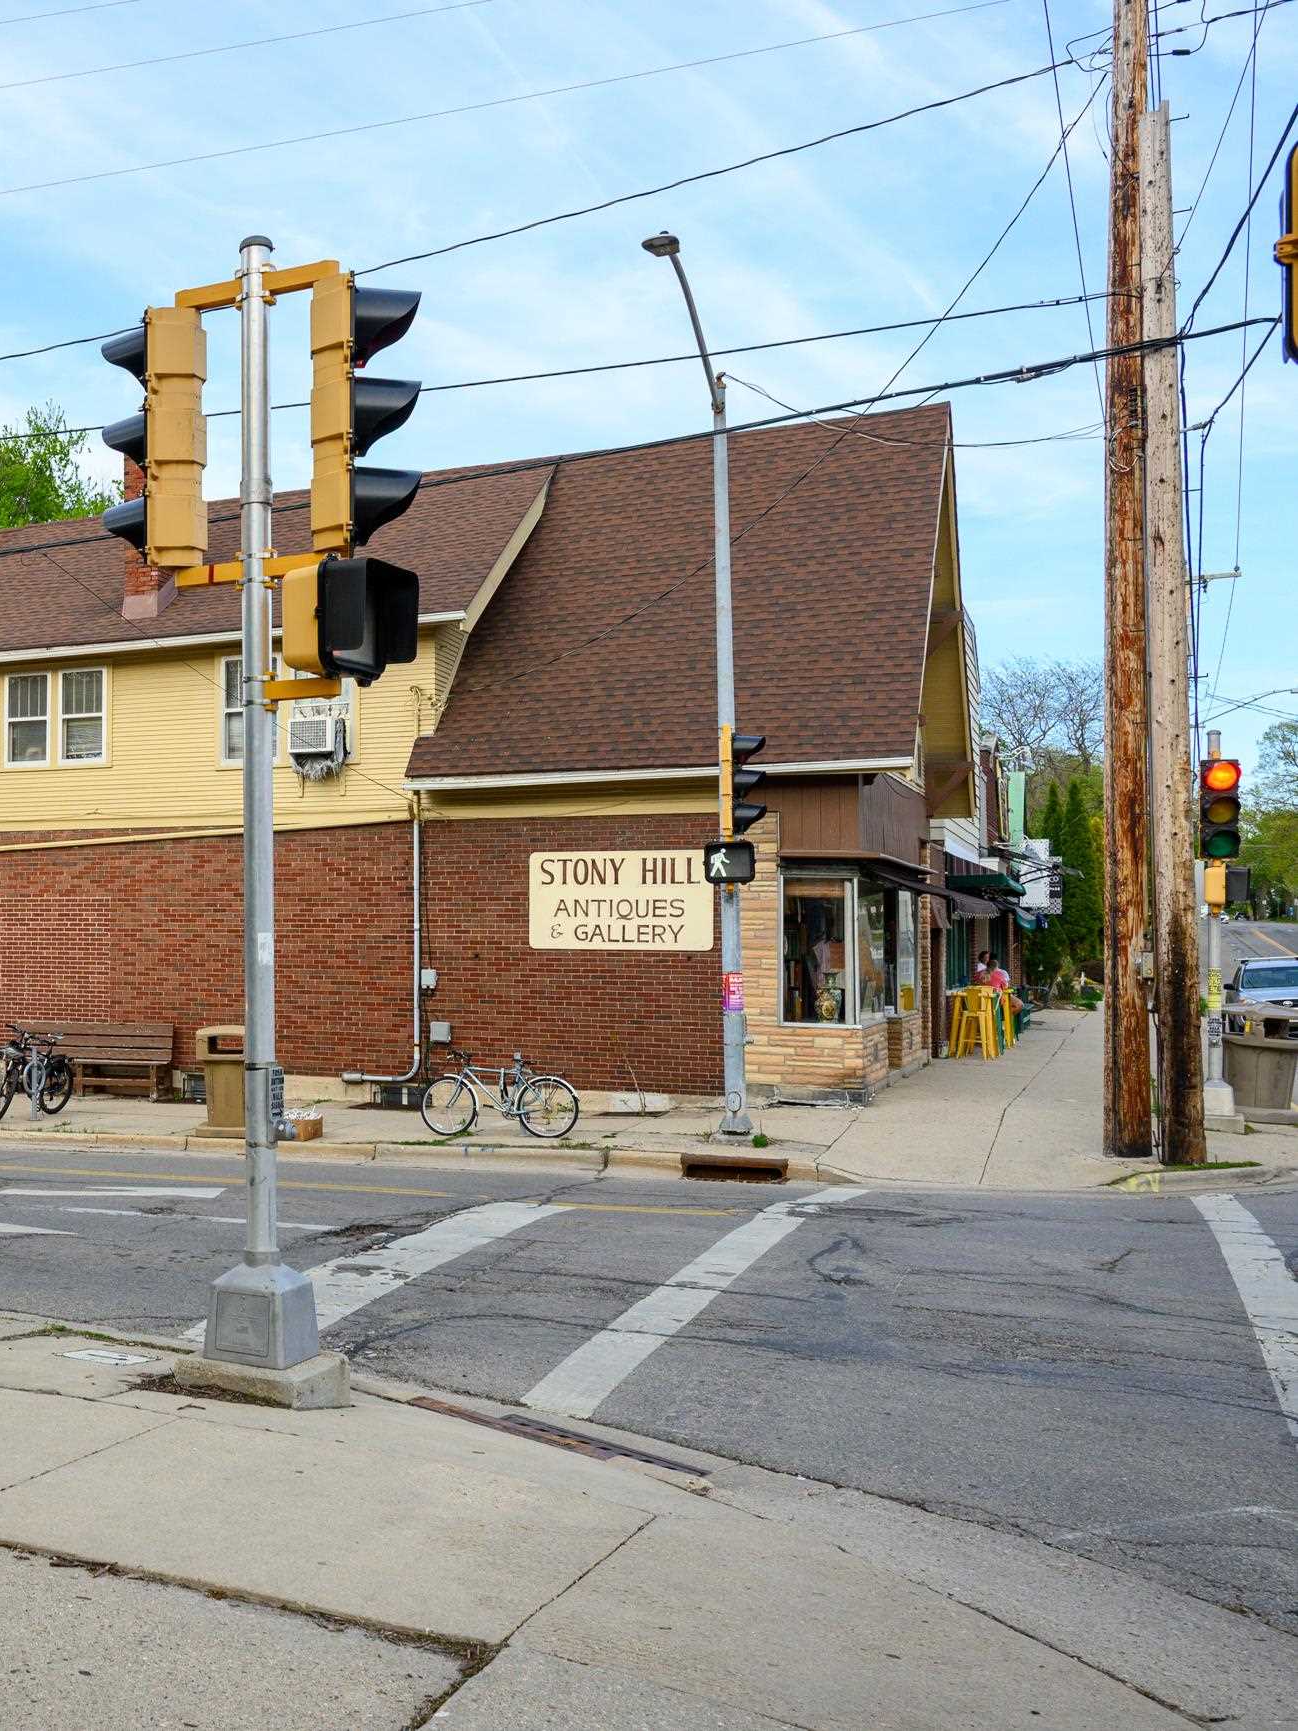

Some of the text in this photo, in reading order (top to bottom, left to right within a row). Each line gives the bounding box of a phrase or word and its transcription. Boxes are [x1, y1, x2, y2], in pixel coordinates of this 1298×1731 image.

[540, 857, 701, 886] STONY HILL
[553, 899, 686, 921] ANTIQUES
[550, 923, 685, 943] & GALLERY
